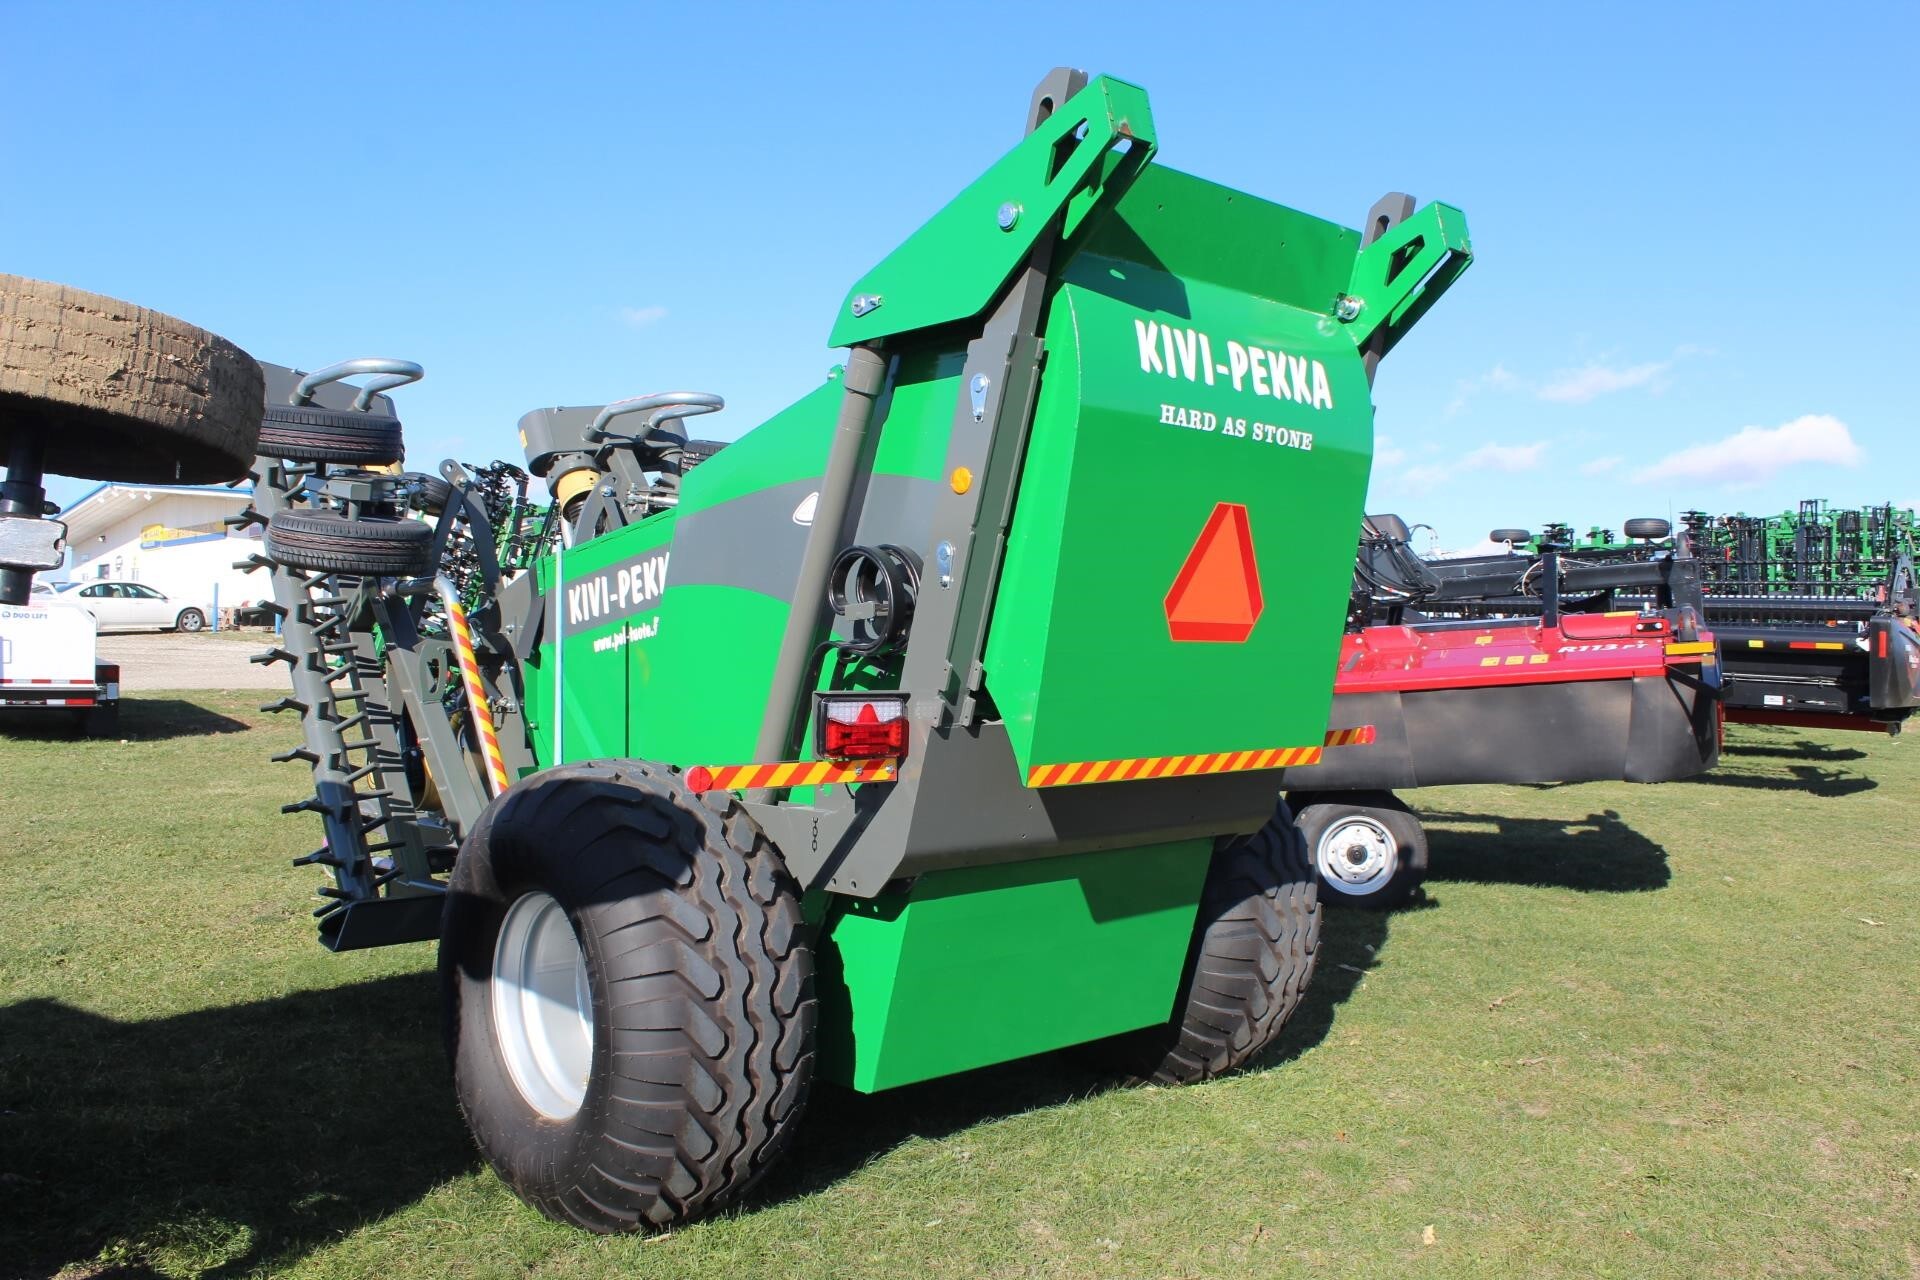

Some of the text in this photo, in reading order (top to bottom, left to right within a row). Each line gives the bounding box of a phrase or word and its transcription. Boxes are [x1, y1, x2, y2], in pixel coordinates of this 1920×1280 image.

[1134, 319, 1333, 410] KIVI-PEKKA
[1159, 403, 1313, 451] HARD AS STONE
